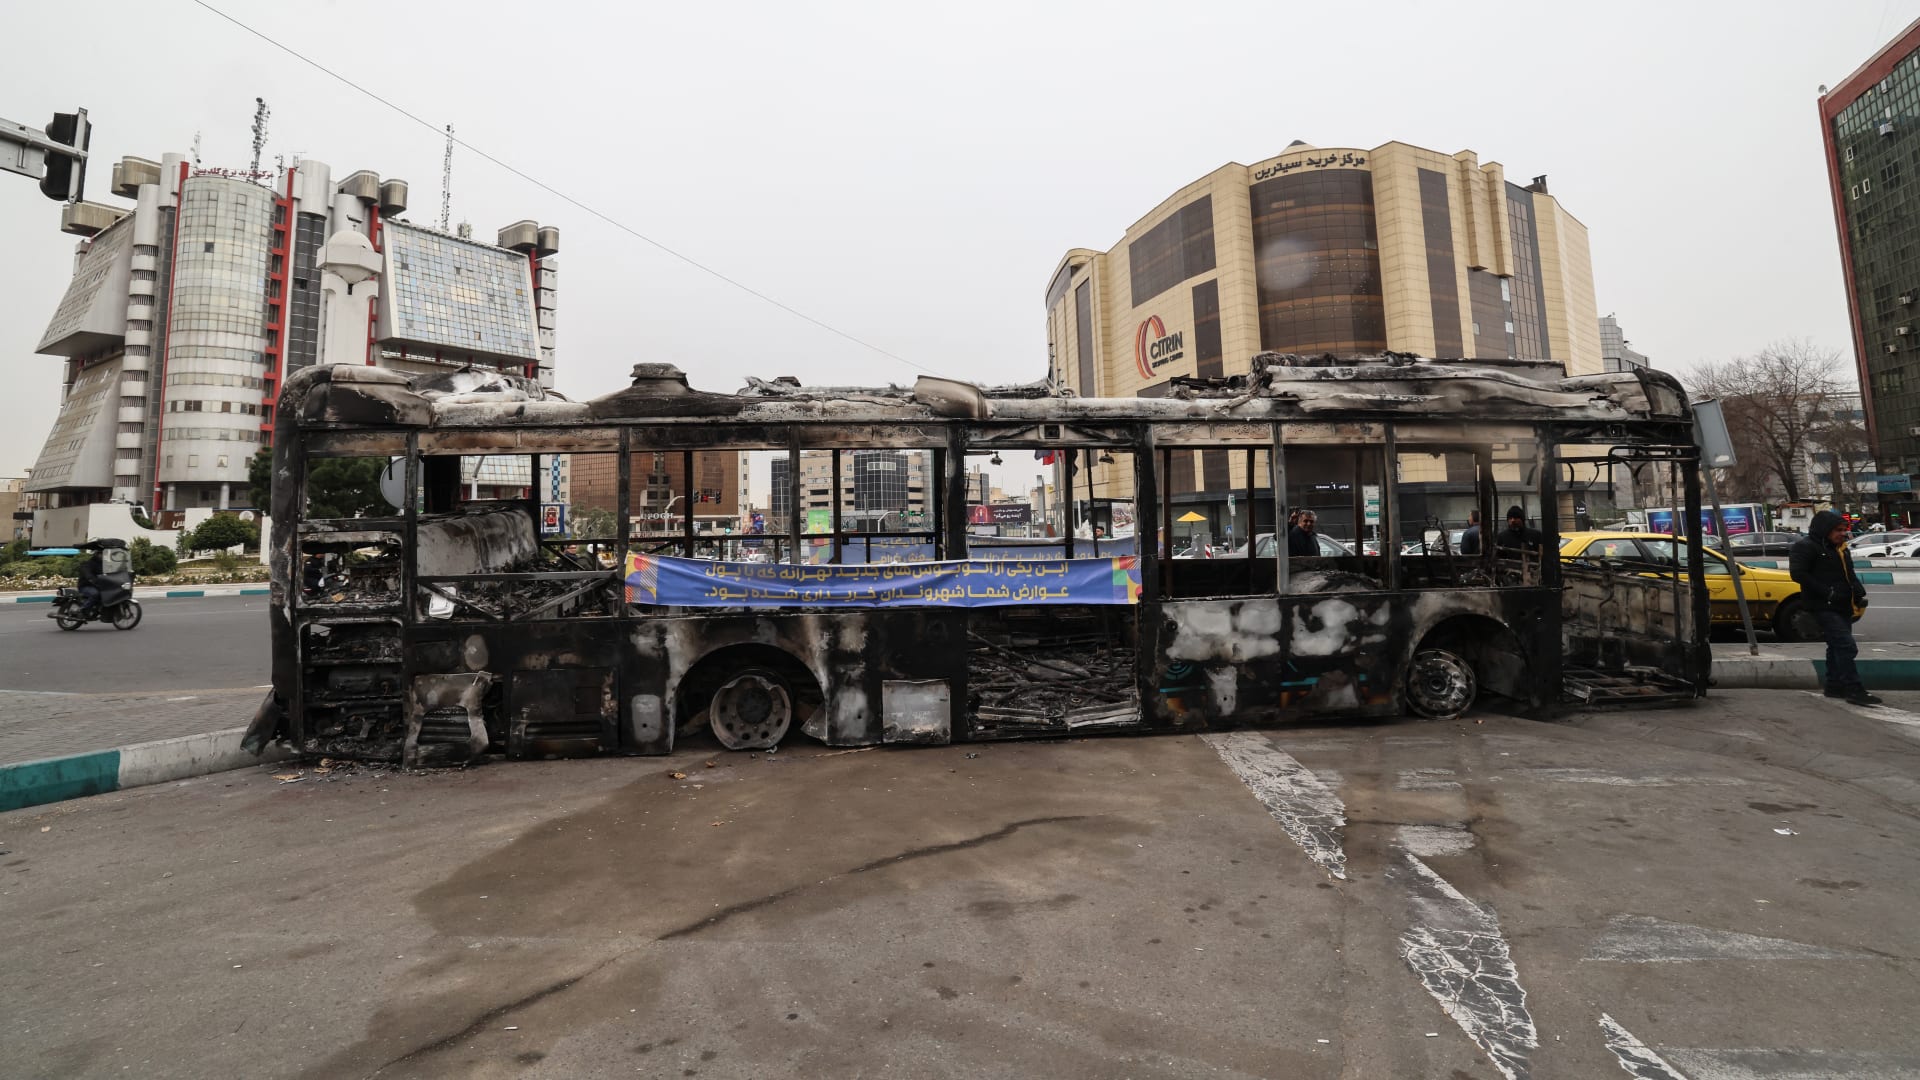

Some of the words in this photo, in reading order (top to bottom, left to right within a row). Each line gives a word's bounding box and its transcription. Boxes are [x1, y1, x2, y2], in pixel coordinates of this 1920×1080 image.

[1306, 153, 1338, 168] خرید
[1339, 152, 1366, 168] مرکز
[1254, 160, 1303, 181] سیترین
[1150, 331, 1184, 360] CITRIN
[705, 563, 742, 582] پول
[743, 565, 755, 578] با
[757, 566, 777, 579] که
[835, 564, 880, 582] جدید
[994, 561, 1006, 577] از
[1005, 561, 1034, 578] یکی
[1034, 561, 1069, 578] این
[704, 586, 749, 601] بود.
[752, 588, 799, 600] شده
[801, 587, 877, 602] خریداری
[880, 586, 965, 603] شهروندان
[967, 584, 1011, 600] شما
[1012, 584, 1069, 602] عوارض
